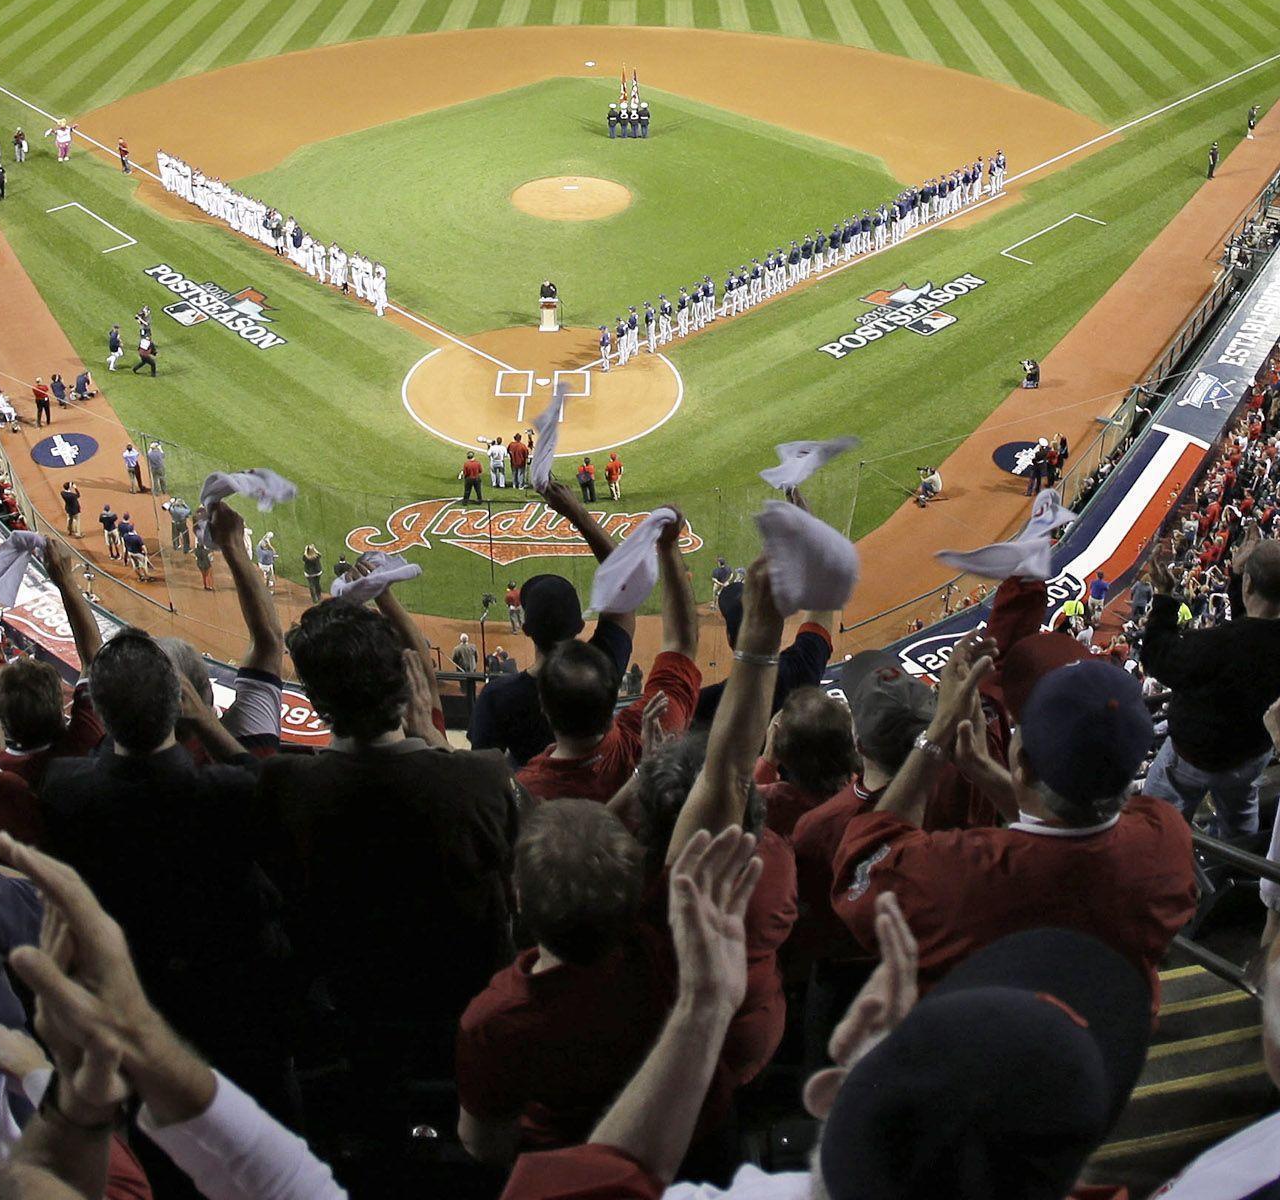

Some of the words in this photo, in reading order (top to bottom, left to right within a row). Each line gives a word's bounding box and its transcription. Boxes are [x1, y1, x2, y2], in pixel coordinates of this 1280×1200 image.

[144, 263, 287, 350] POSTSEASON
[199, 281, 230, 300] 2013
[818, 272, 987, 359] POSTSEASON
[855, 306, 892, 325] 2013
[346, 497, 704, 566] Indian
[280, 703, 324, 730] 97
